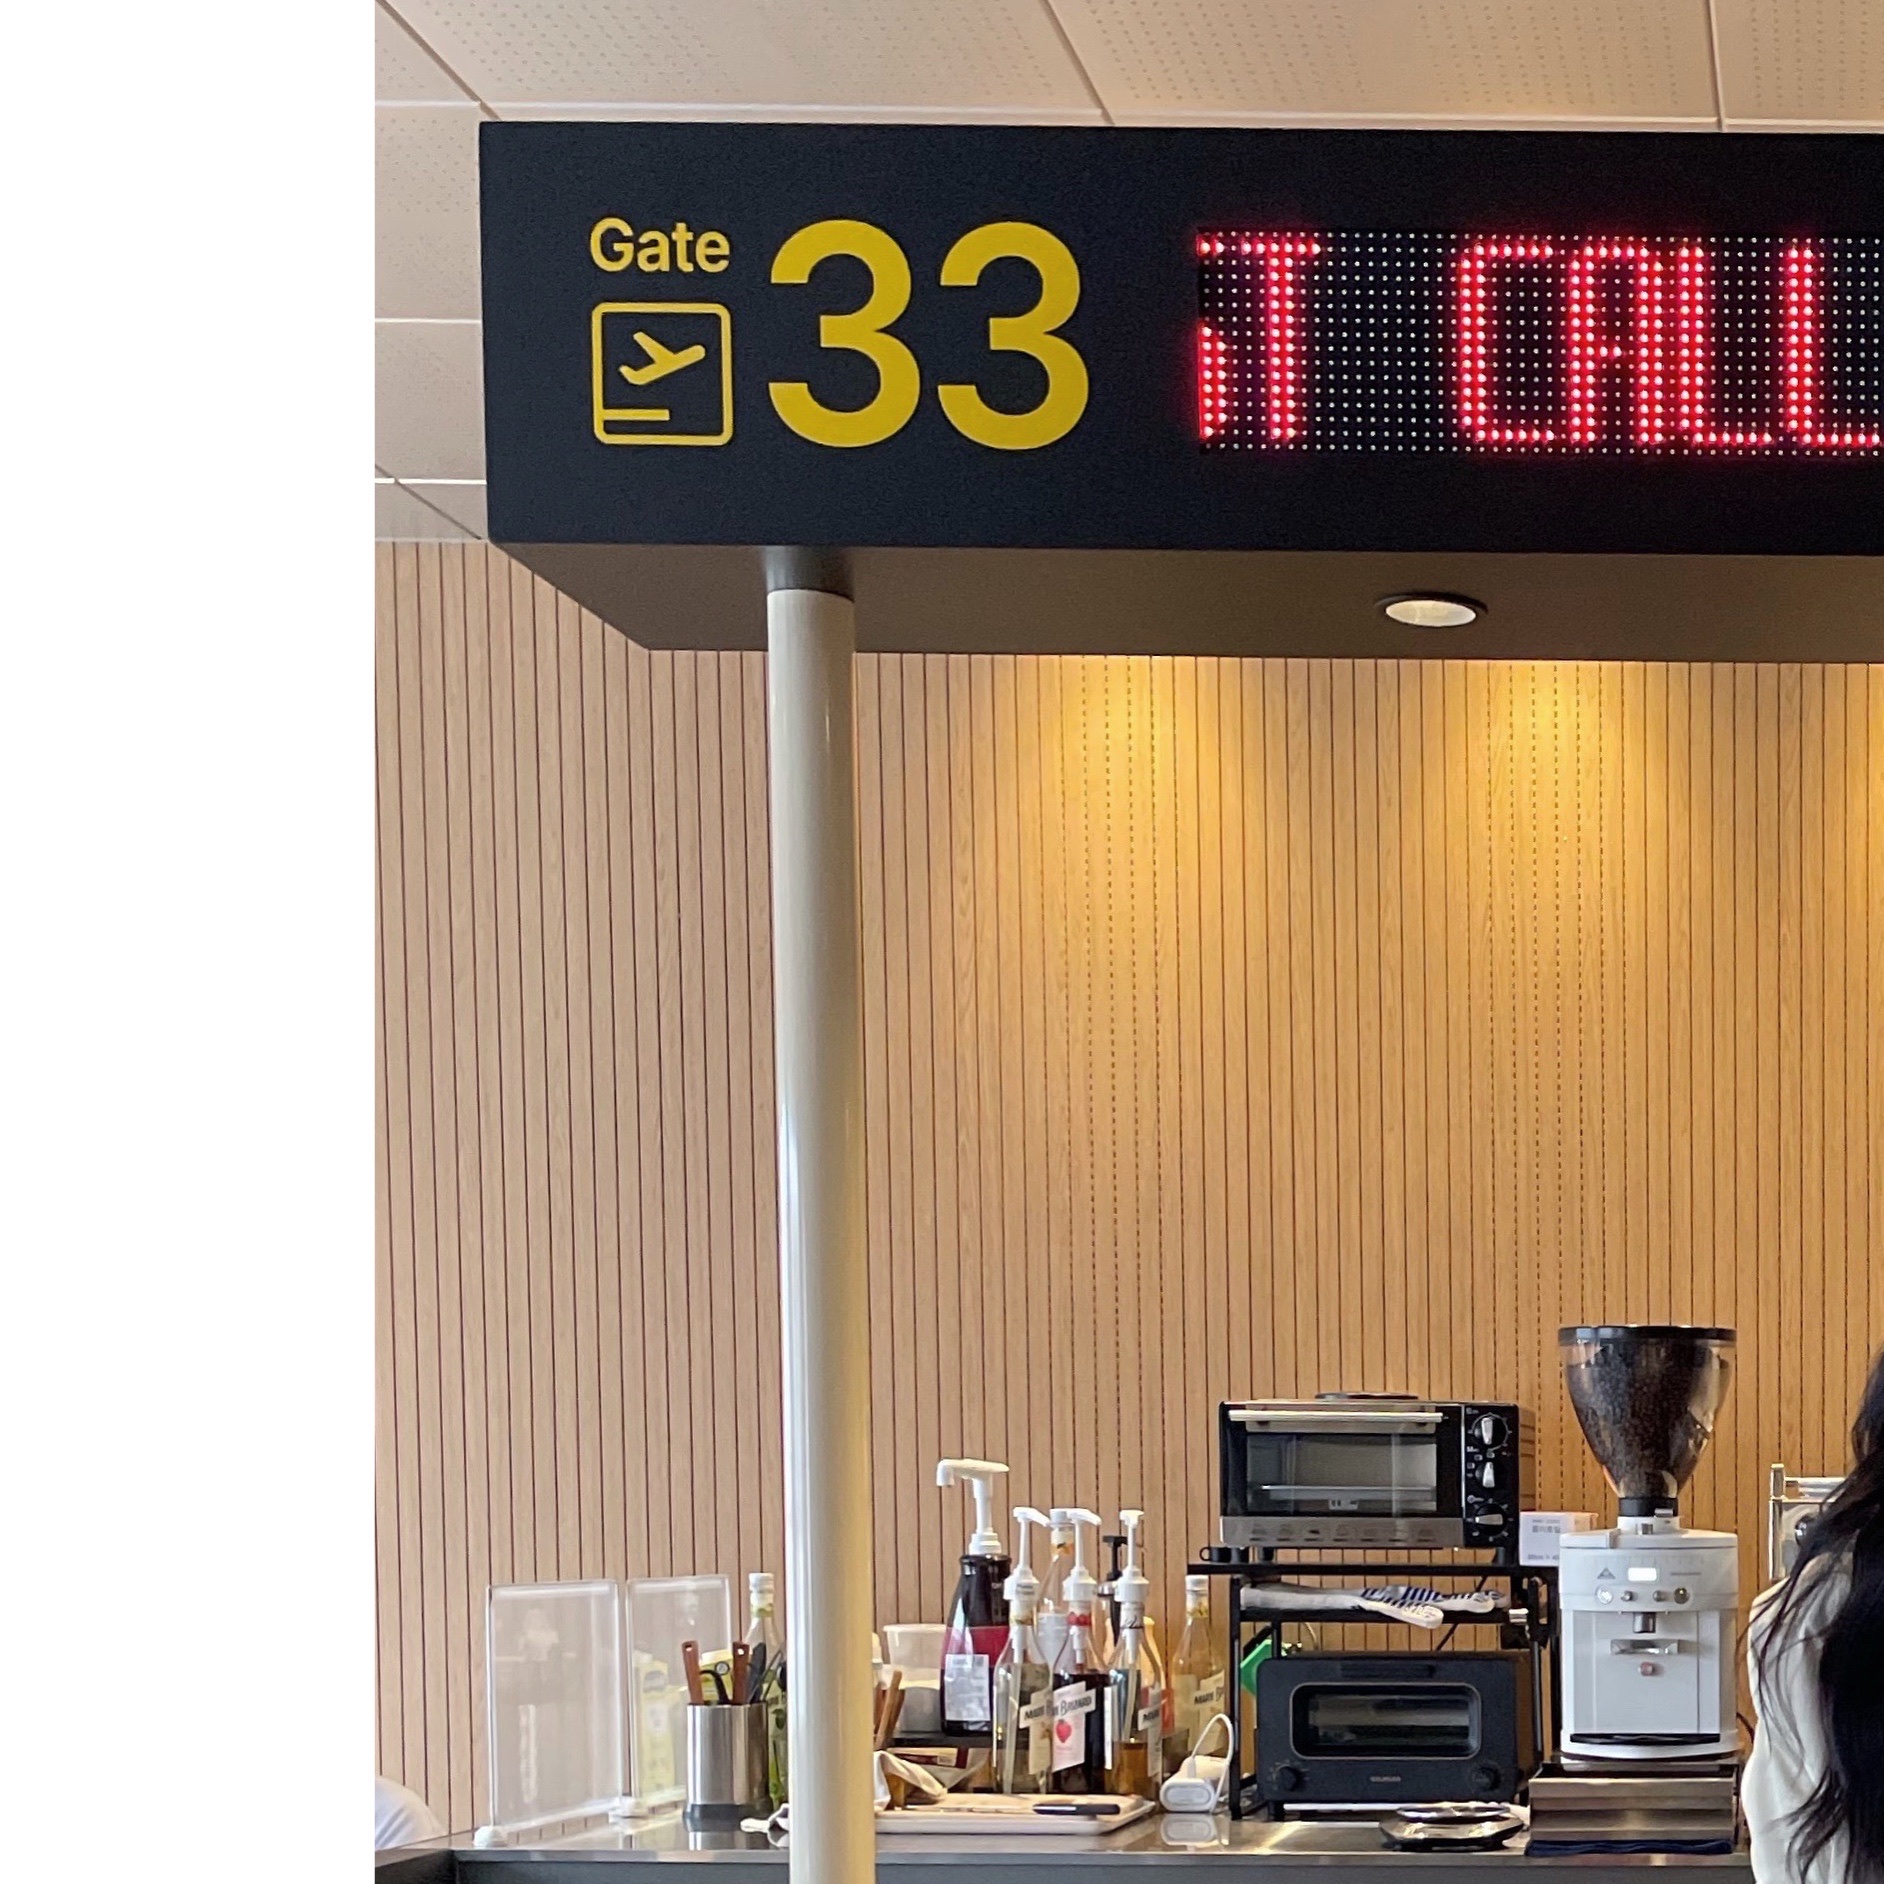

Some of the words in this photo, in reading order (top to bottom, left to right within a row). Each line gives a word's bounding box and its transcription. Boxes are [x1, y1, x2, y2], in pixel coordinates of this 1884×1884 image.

[590, 217, 731, 273] Gate
[769, 219, 1090, 452] 33
[1457, 236, 1884, 450] CALL
